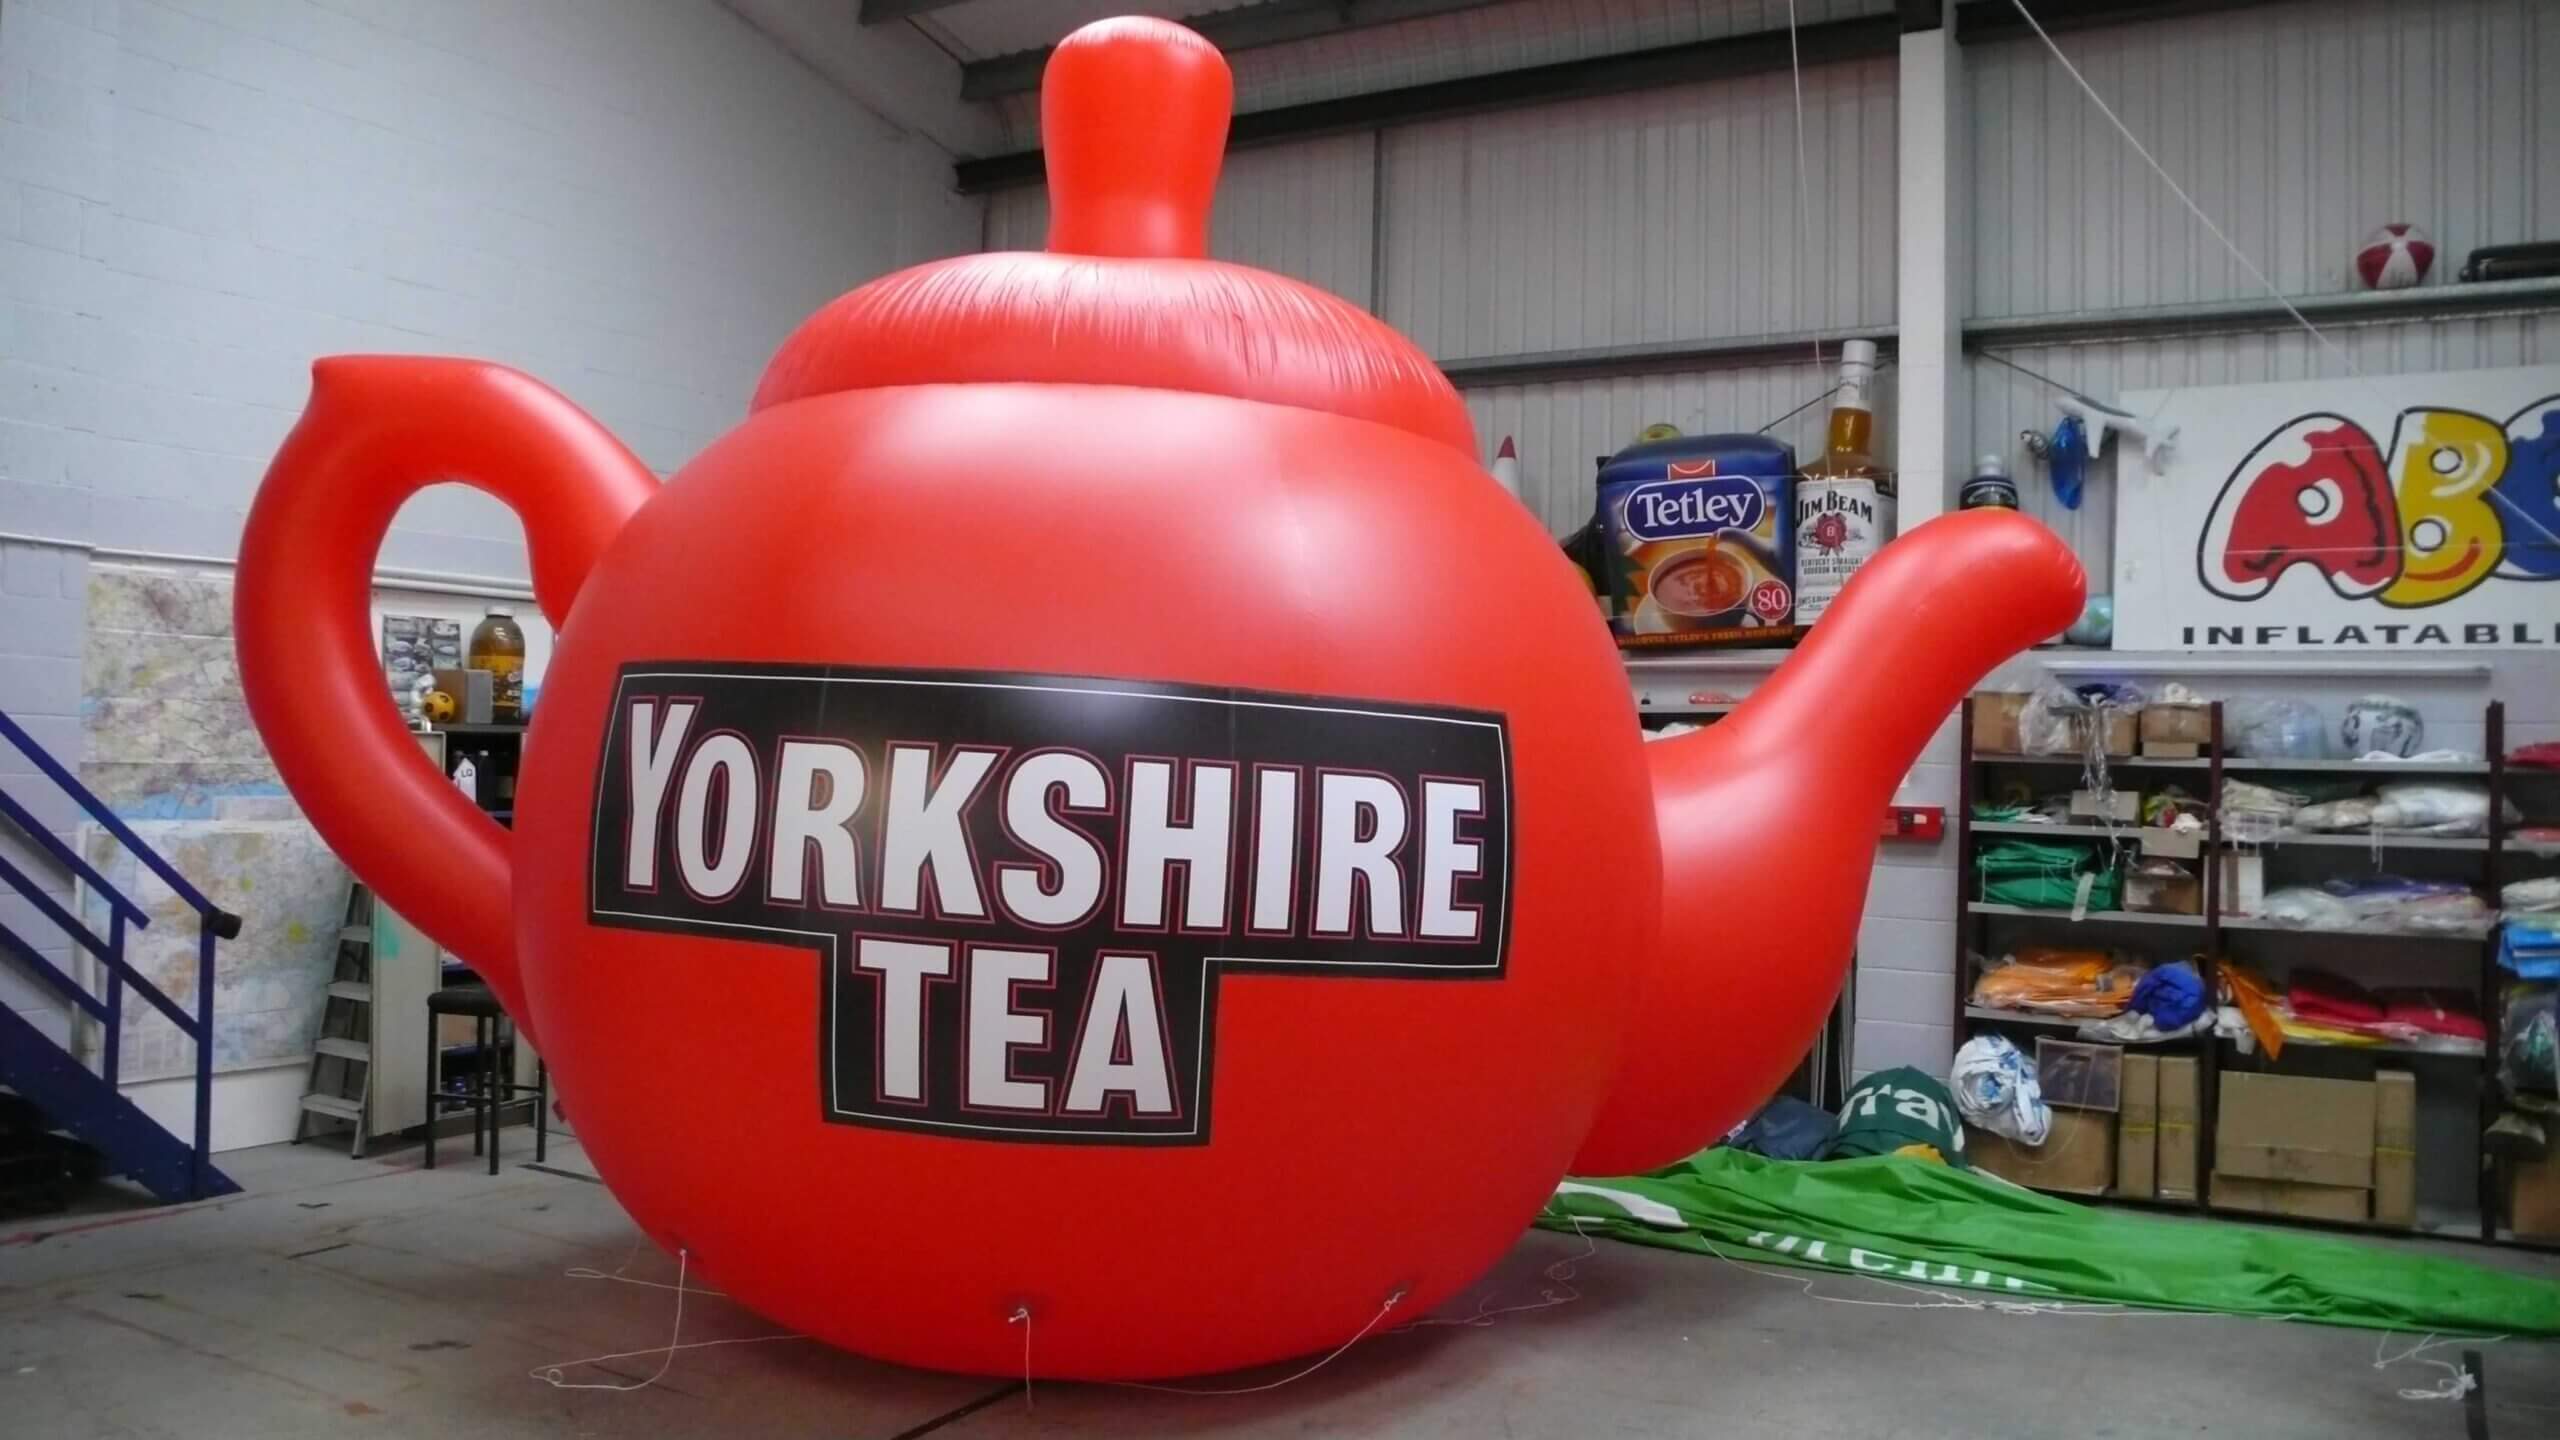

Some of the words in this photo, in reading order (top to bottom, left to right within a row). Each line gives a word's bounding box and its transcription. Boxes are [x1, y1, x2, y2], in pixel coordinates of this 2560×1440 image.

[1636, 487, 1755, 528] Tetley
[1796, 498, 1823, 528] JIM
[1826, 489, 1873, 525] BEAM
[1757, 588, 1787, 612] 80
[2183, 623, 2560, 645] INFLATABL
[622, 695, 1486, 943] YORKSHIRE
[852, 931, 1182, 1119] TEA
